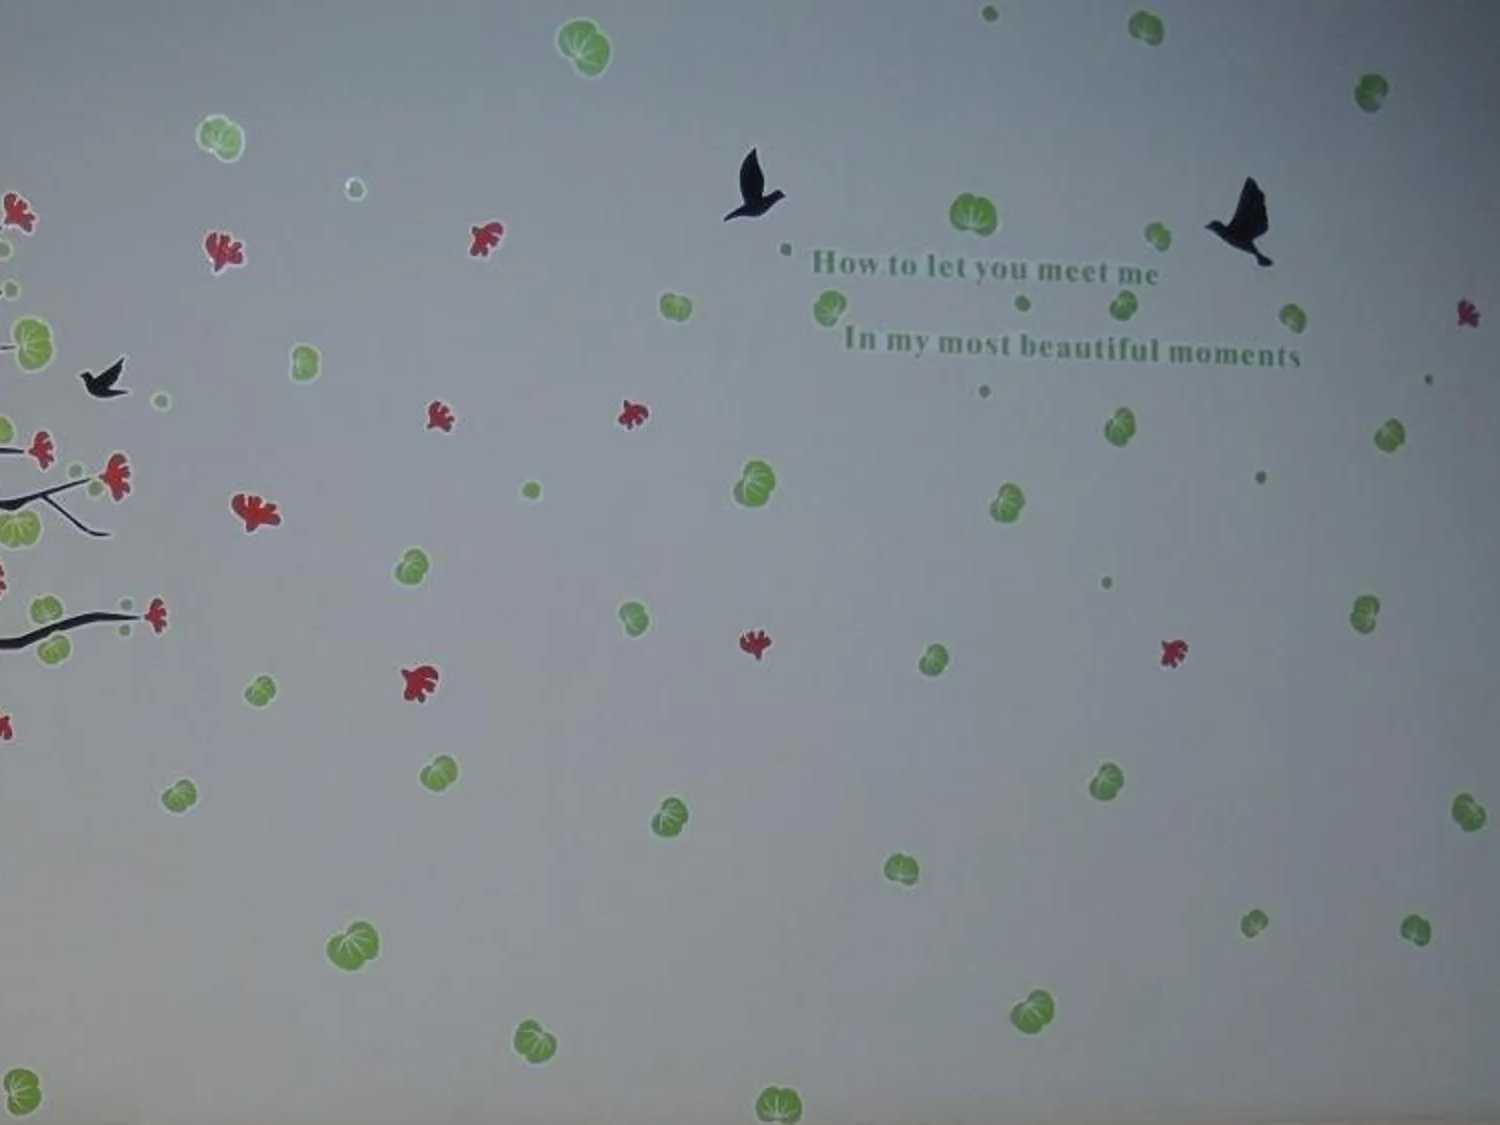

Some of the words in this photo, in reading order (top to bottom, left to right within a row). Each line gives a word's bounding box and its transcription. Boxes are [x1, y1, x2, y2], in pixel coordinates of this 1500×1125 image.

[813, 249, 878, 274] How
[888, 255, 918, 276] to
[928, 254, 966, 278] let
[975, 259, 1028, 286] you
[1038, 260, 1108, 283] meet
[1118, 265, 1159, 286] me
[844, 325, 876, 352] In
[886, 333, 928, 359] my
[938, 333, 1011, 356] most
[1020, 332, 1160, 363] beautiful
[1169, 343, 1301, 368] moments
